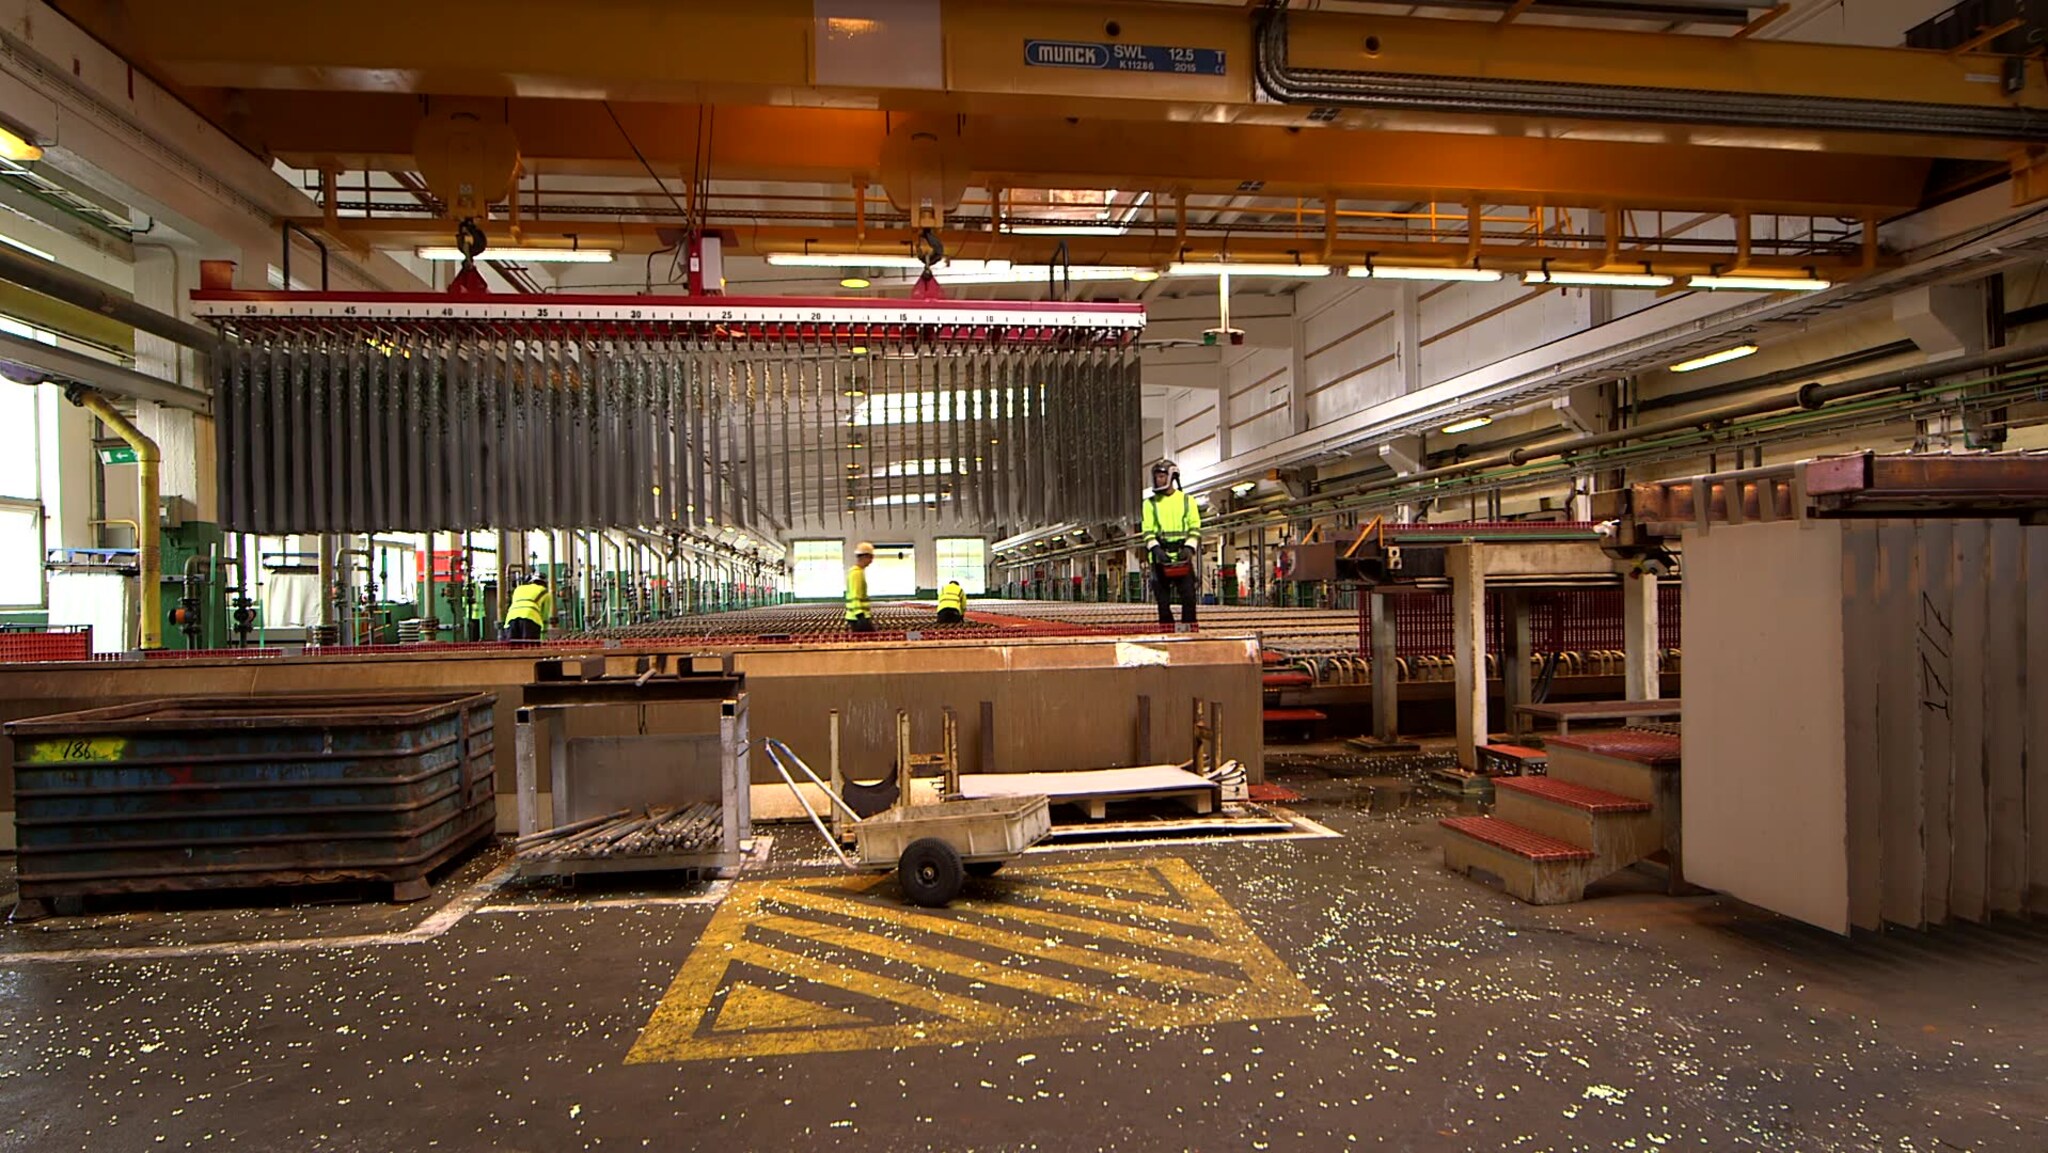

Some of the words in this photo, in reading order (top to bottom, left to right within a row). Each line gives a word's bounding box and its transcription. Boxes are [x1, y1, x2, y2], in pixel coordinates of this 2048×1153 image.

[1039, 45, 1097, 65] MUNCK
[1113, 44, 1147, 60] SWL
[1215, 50, 1225, 63] T
[1174, 62, 1197, 73] 2015
[245, 305, 258, 315] 50
[344, 305, 357, 315] 45
[442, 307, 454, 317] 40
[537, 308, 549, 317] 35
[630, 310, 642, 319] 30
[721, 311, 733, 319] 25
[811, 312, 821, 321] 20
[899, 313, 908, 322] 15
[985, 315, 994, 323] 10
